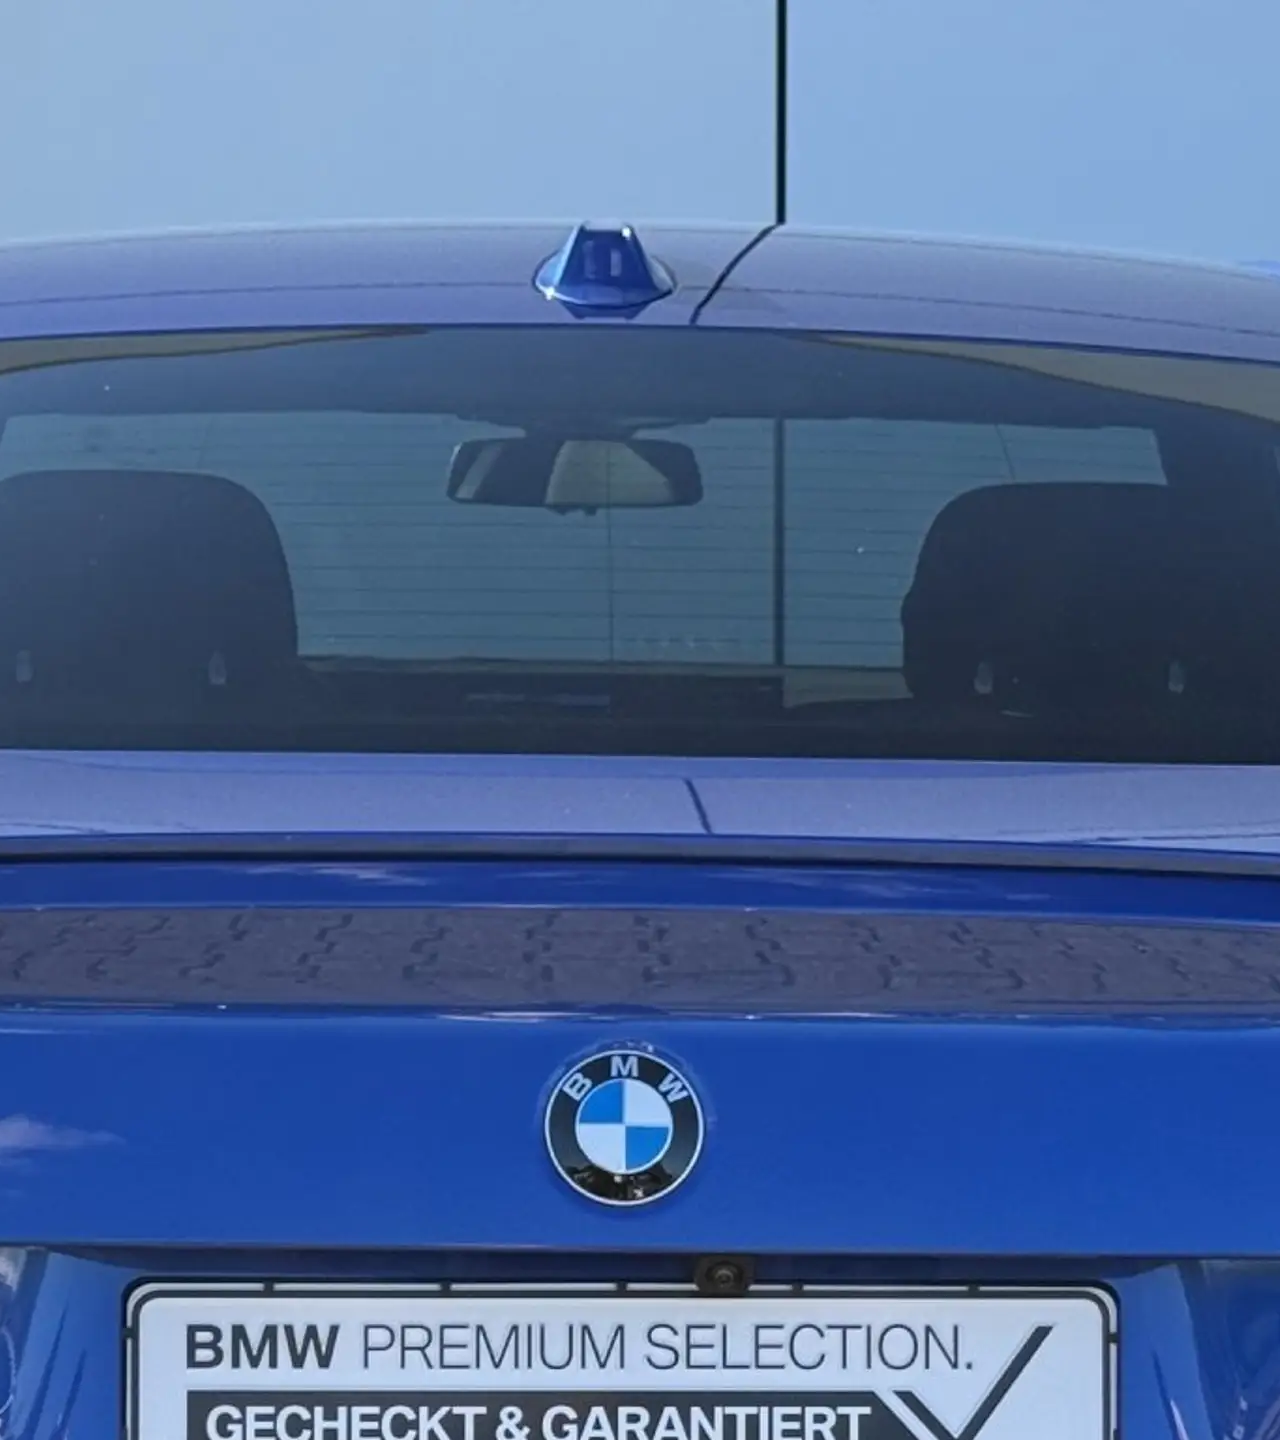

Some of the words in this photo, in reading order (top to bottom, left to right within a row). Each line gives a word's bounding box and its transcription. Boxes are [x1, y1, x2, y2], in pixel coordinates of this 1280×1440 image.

[562, 1056, 688, 1102] BMW
[186, 1324, 340, 1369] BMW
[363, 1324, 625, 1369] PREMIUM
[646, 1324, 973, 1370] SELECTION.
